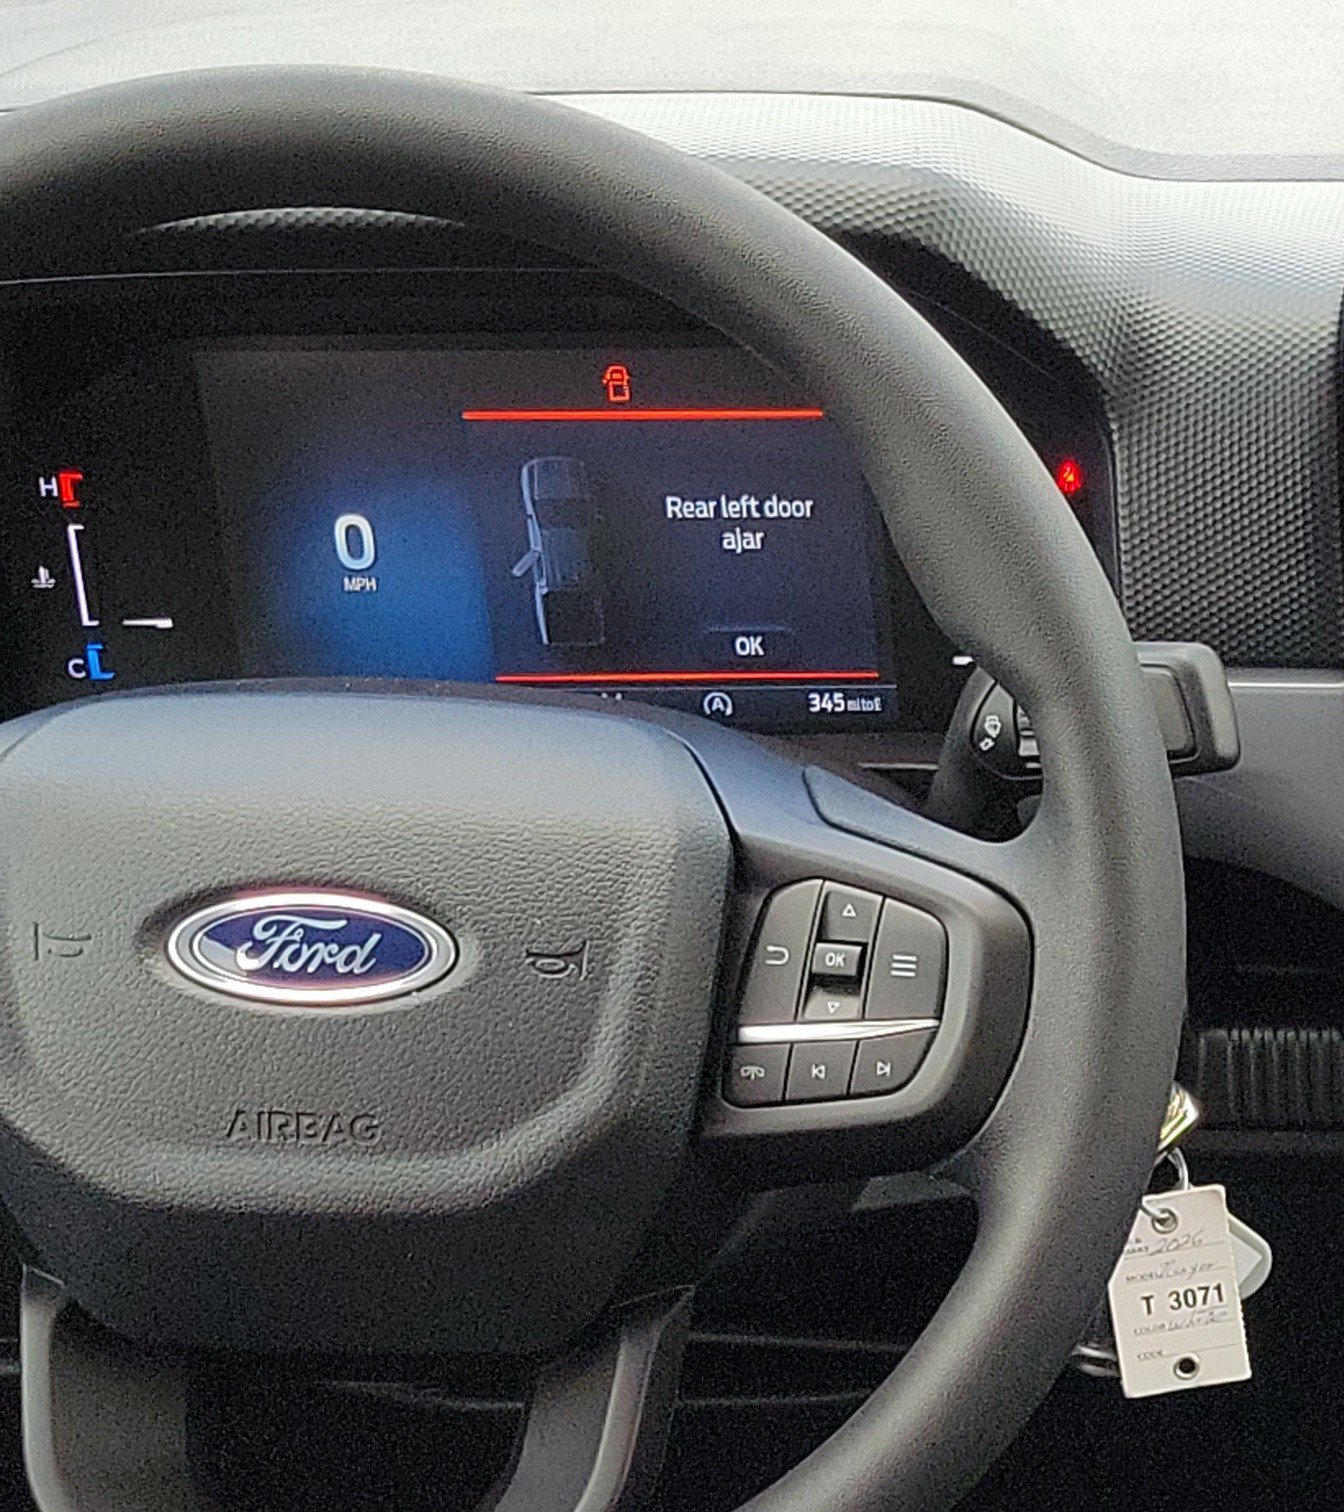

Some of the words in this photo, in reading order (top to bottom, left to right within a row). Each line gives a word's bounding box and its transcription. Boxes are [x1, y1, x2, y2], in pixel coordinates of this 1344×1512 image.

[665, 496, 716, 518] Rear
[720, 494, 760, 518] left
[763, 494, 814, 518] door
[333, 512, 376, 571] 0
[721, 527, 764, 553] ajar
[343, 576, 377, 592] MPH
[735, 637, 765, 657] OK
[807, 692, 845, 713] 345
[236, 914, 382, 975] Ford
[824, 952, 845, 968] OK
[226, 1109, 384, 1145] AIRBAG
[1141, 1294, 1155, 1316] T
[1168, 1282, 1226, 1311] 3071
